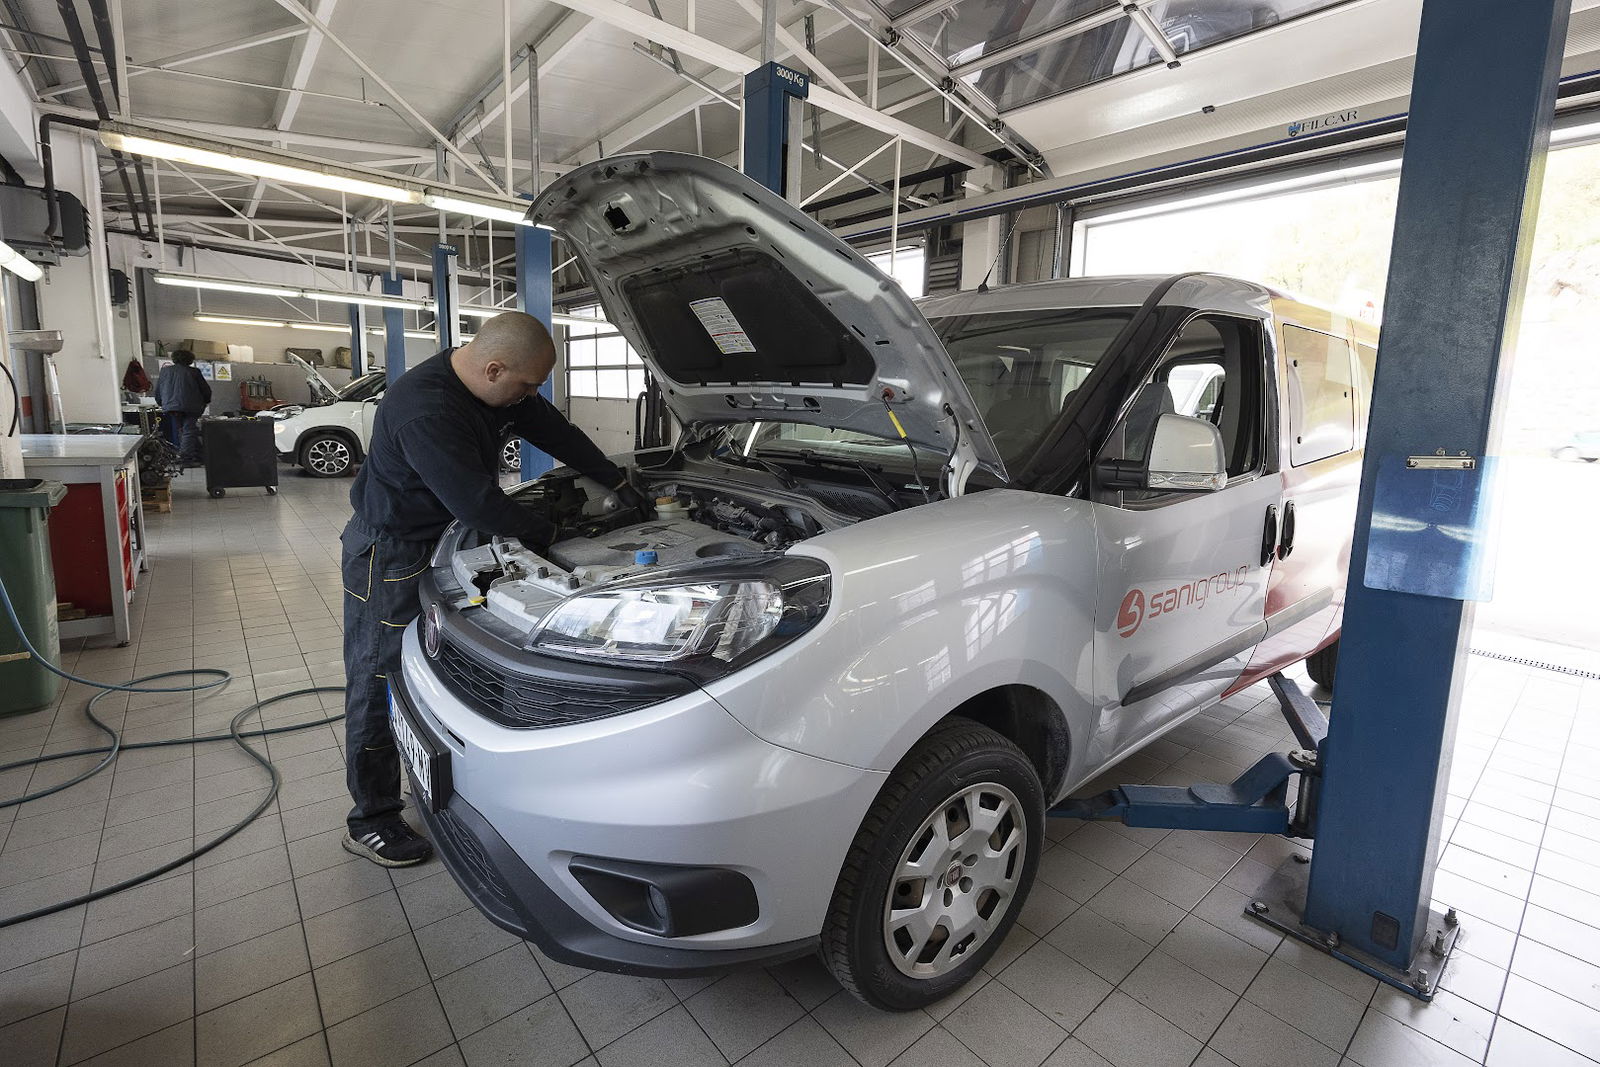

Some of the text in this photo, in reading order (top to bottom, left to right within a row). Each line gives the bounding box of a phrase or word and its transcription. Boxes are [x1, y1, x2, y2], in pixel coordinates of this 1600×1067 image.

[776, 66, 804, 87] 3000 Kg
[1301, 110, 1358, 132] FILCAR
[1148, 565, 1248, 619] sanigroup
